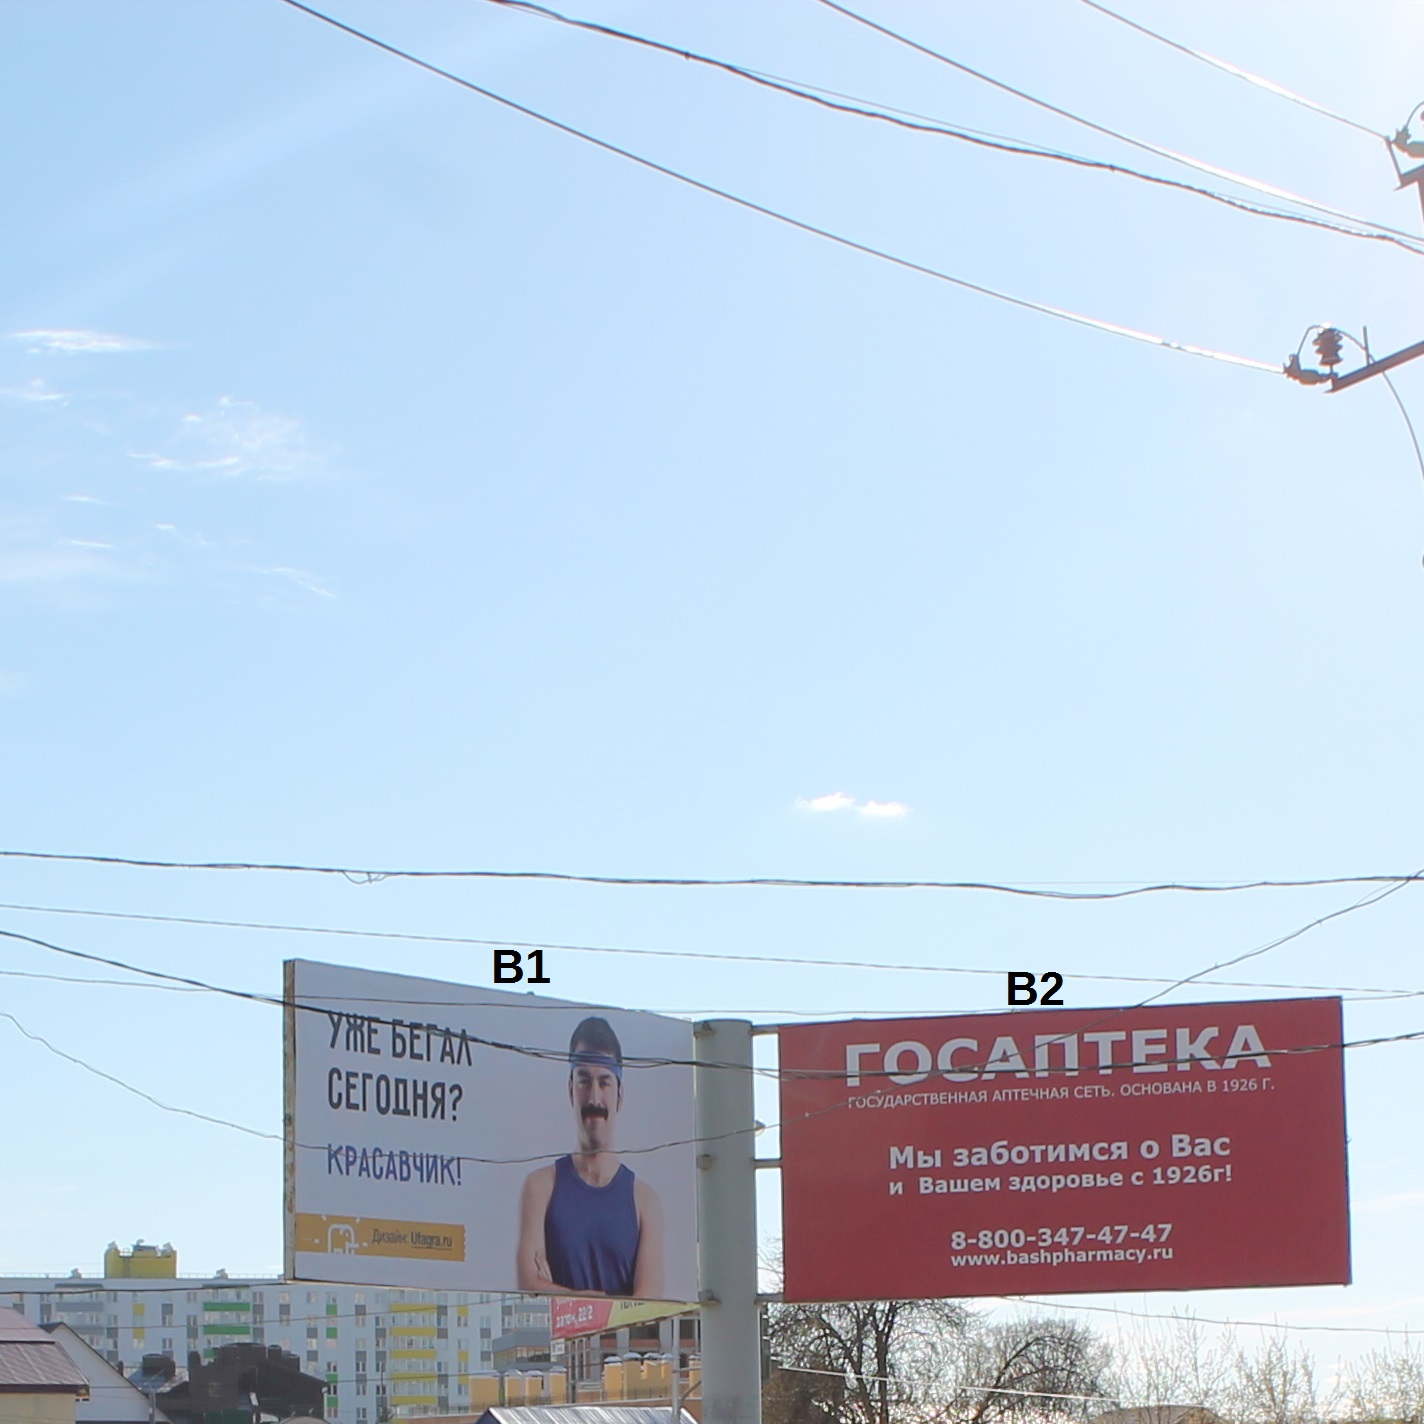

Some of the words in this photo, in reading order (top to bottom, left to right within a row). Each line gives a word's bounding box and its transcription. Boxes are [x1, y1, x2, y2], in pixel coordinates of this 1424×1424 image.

[327, 1010, 381, 1055] УЖЕ
[392, 1019, 472, 1066] БЕГАЛ
[845, 1024, 1272, 1087] ГОСАПТЕКА
[328, 1067, 463, 1122] СЕГОДНЯ?
[848, 1089, 987, 1109] ГОСУДАРСТВЕННАЯ
[992, 1086, 1069, 1102] АПТЕЧНАЯ
[1074, 1084, 1115, 1099] СЕТЬ.
[1120, 1080, 1202, 1096] ОСНОВАНА
[1207, 1080, 1217, 1092] В
[1223, 1078, 1258, 1092] 1926
[1262, 1077, 1275, 1090] Г.
[327, 1143, 461, 1186] КРАСАВЧИК!
[889, 1145, 942, 1169] Мы
[953, 1140, 1128, 1167] заботимся
[1140, 1140, 1160, 1159] о
[1171, 1134, 1231, 1158] Вас
[889, 1180, 904, 1195] и
[919, 1176, 1001, 1194] Вашем
[1008, 1172, 1123, 1192] здоровье
[1131, 1172, 1143, 1186] с
[1152, 1164, 1232, 1184] 1926г!
[950, 1223, 1173, 1250] 8-800-347-47-47
[951, 1246, 1174, 1266] www.bashpharmacy.ru
